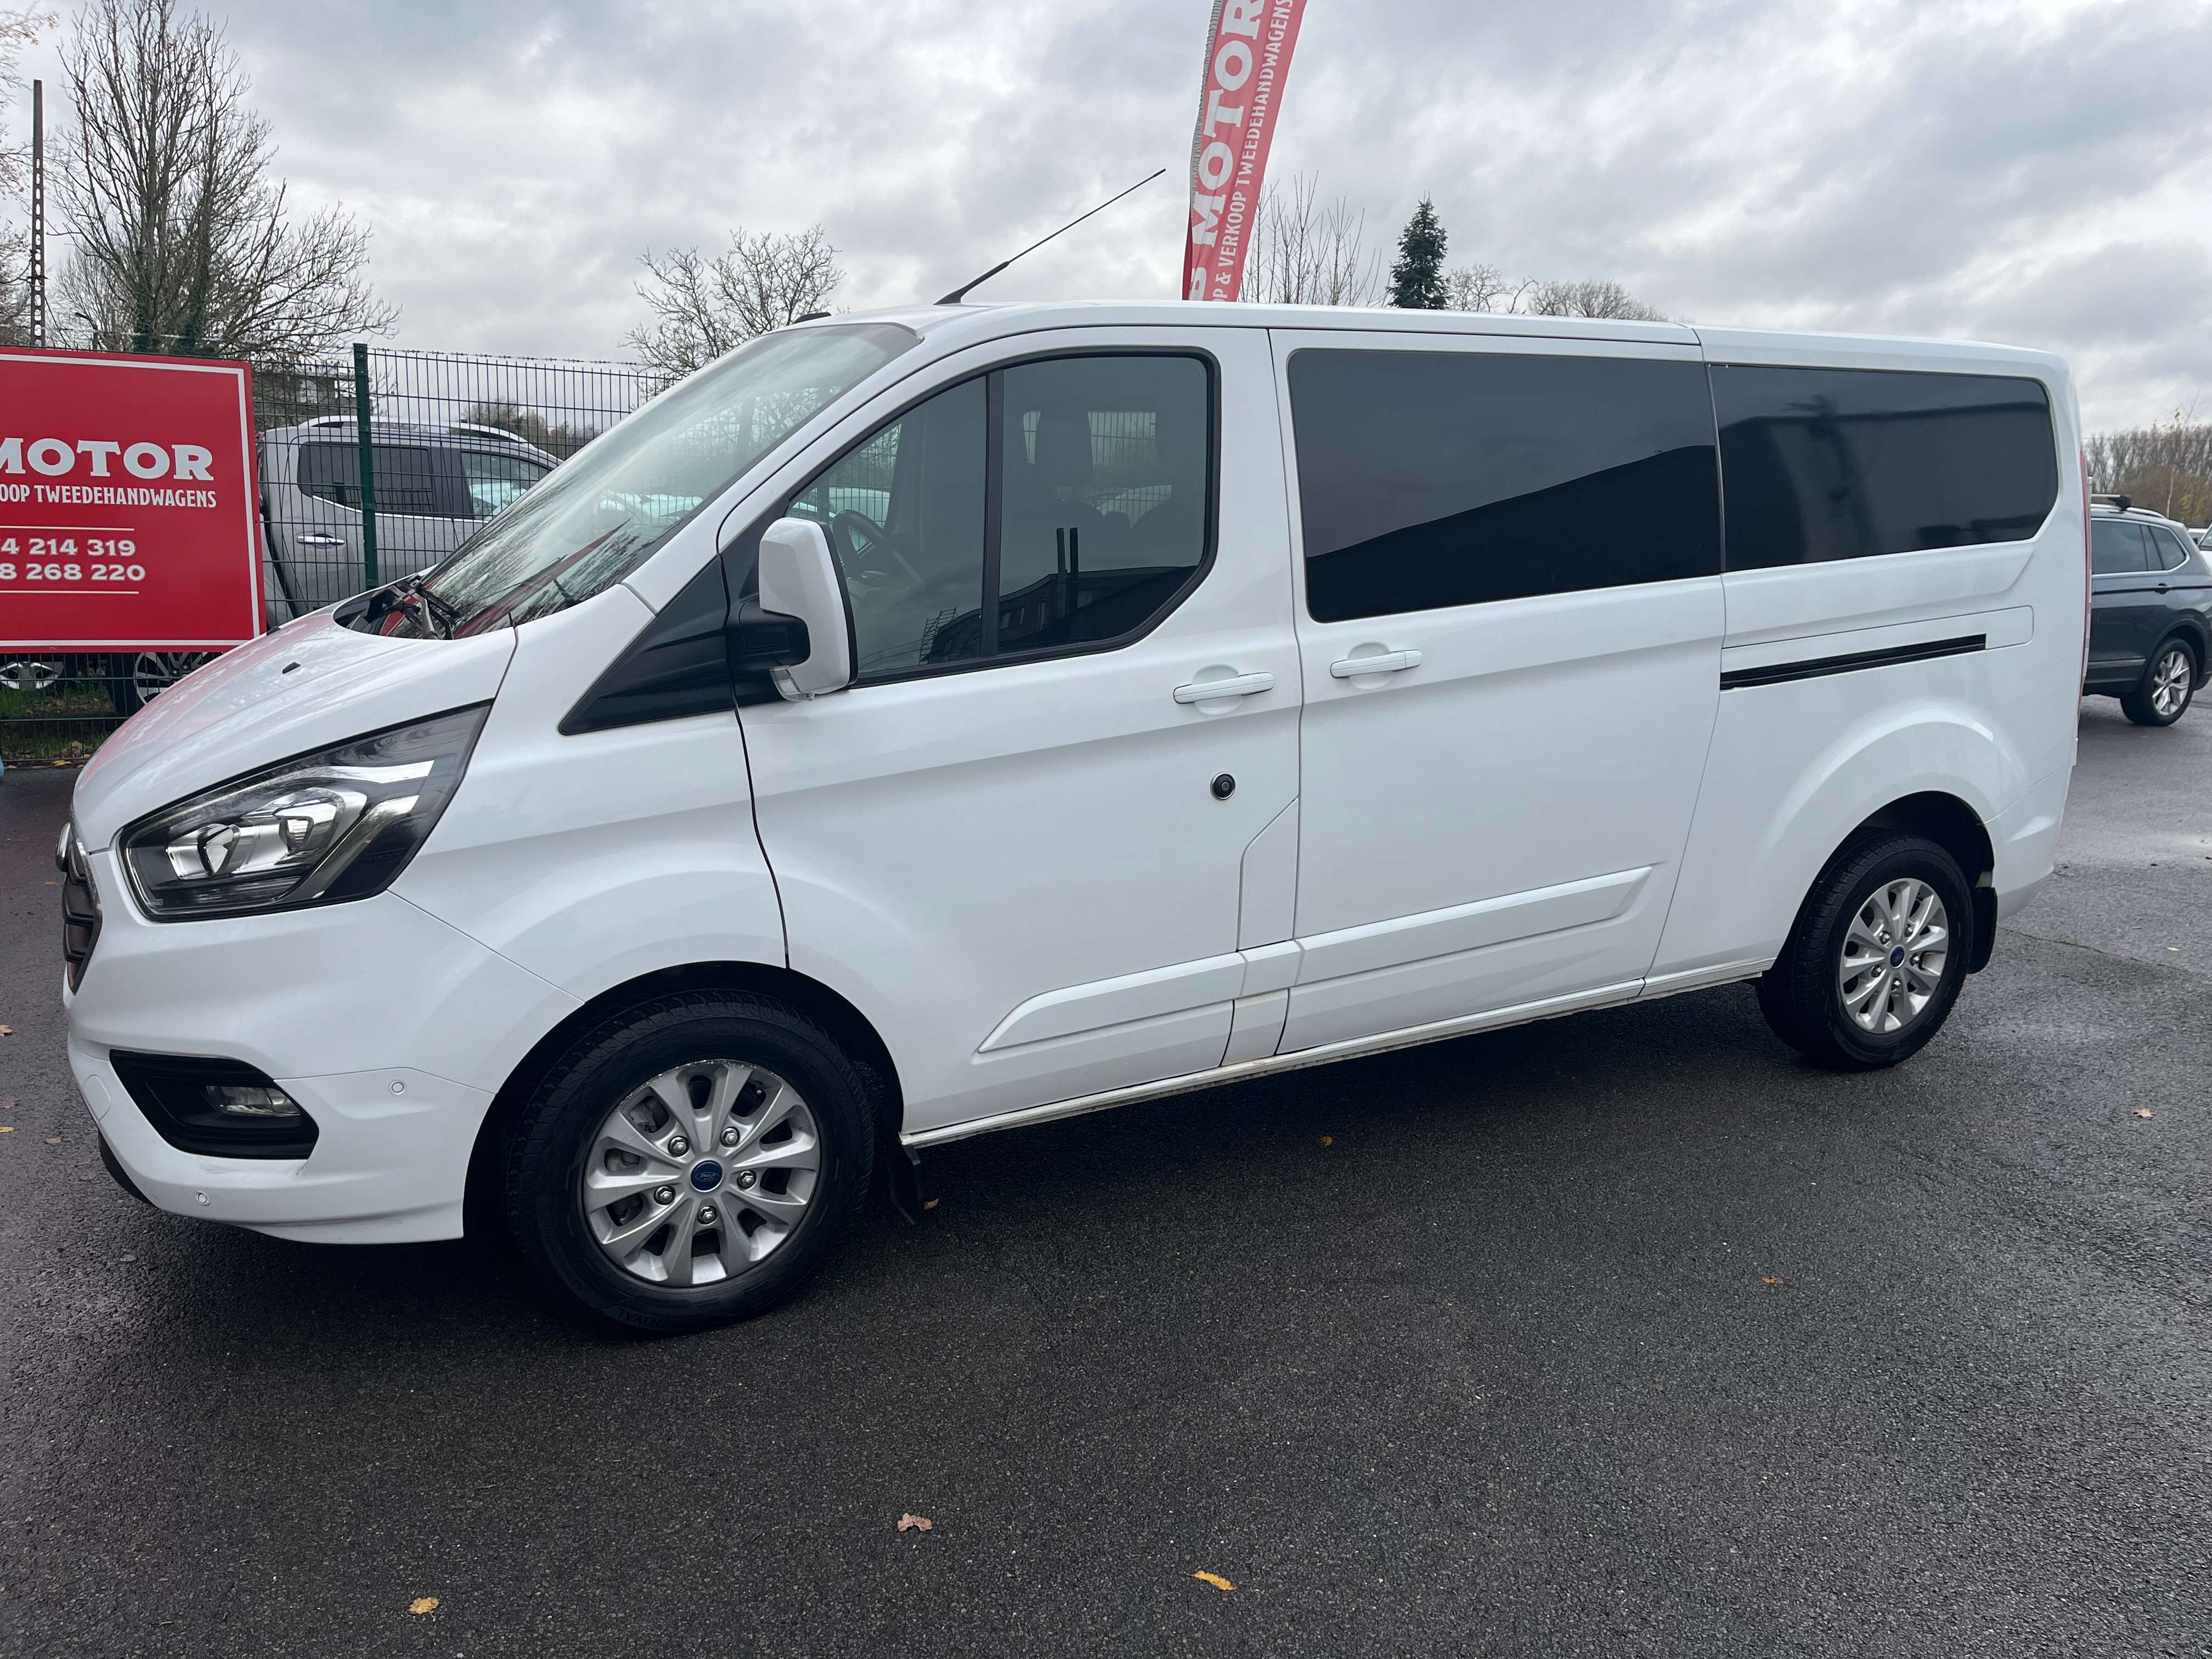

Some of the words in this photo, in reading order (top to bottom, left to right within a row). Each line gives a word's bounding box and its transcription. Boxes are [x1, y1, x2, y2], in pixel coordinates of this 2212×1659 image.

[1235, 0, 1294, 187] TWEEDEHANDWAGENS
[1192, 0, 1265, 248] MOTOR
[1217, 191, 1247, 267] VERKOOP
[1215, 272, 1232, 285] &
[34, 484, 217, 508] TWEEDEHANDWAGENS
[29, 538, 78, 556] 214
[87, 539, 136, 556] 319
[26, 563, 82, 580] 268
[91, 564, 146, 581] 220
